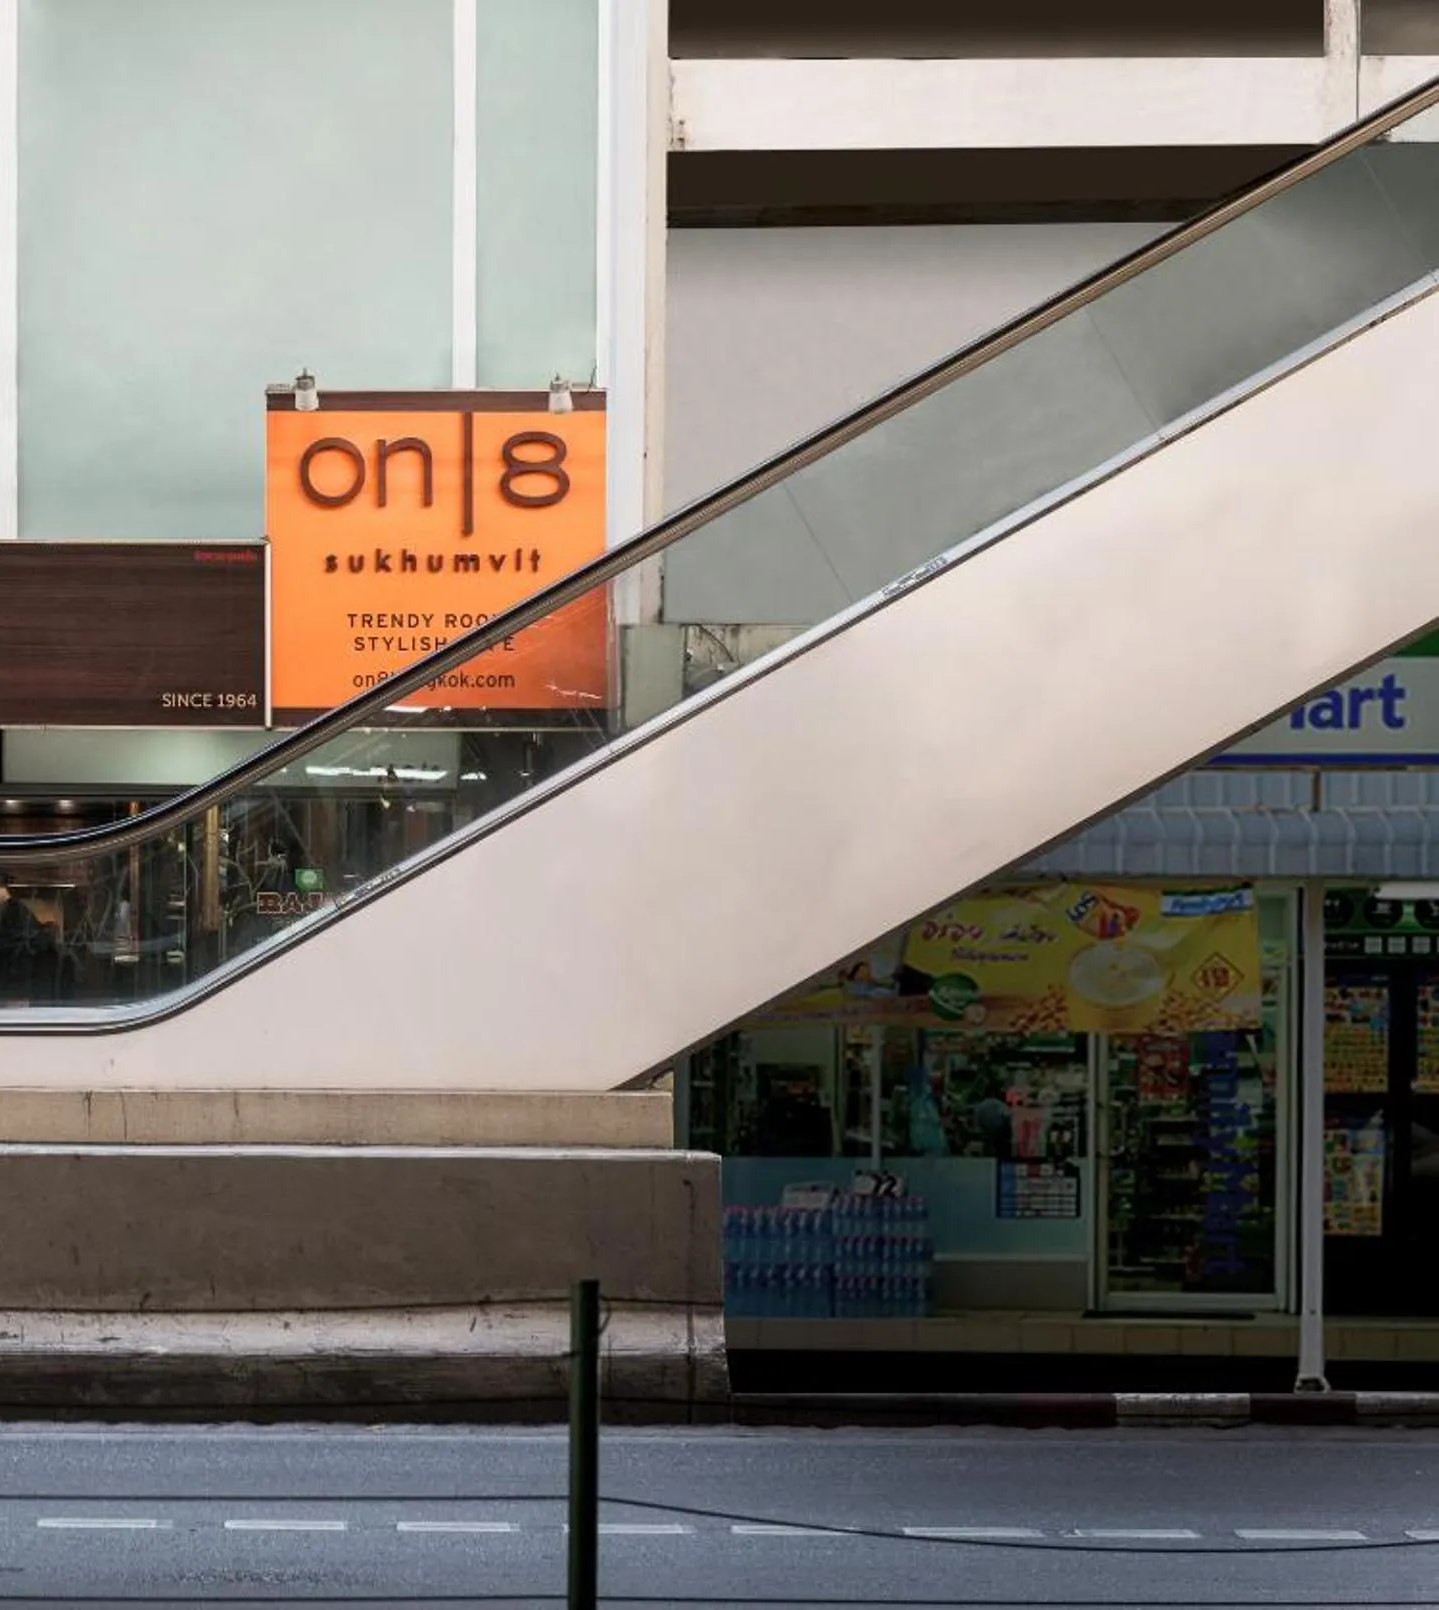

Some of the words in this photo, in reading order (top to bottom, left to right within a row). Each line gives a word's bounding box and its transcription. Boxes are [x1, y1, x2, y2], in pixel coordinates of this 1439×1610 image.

[324, 549, 541, 574] sukhumvit
[347, 613, 434, 628] TRENDY
[445, 613, 498, 628] ROO
[354, 636, 447, 652] STYLISH
[353, 671, 515, 691] on8gkok.com
[162, 693, 212, 709] SINCE
[217, 693, 258, 709] 1964
